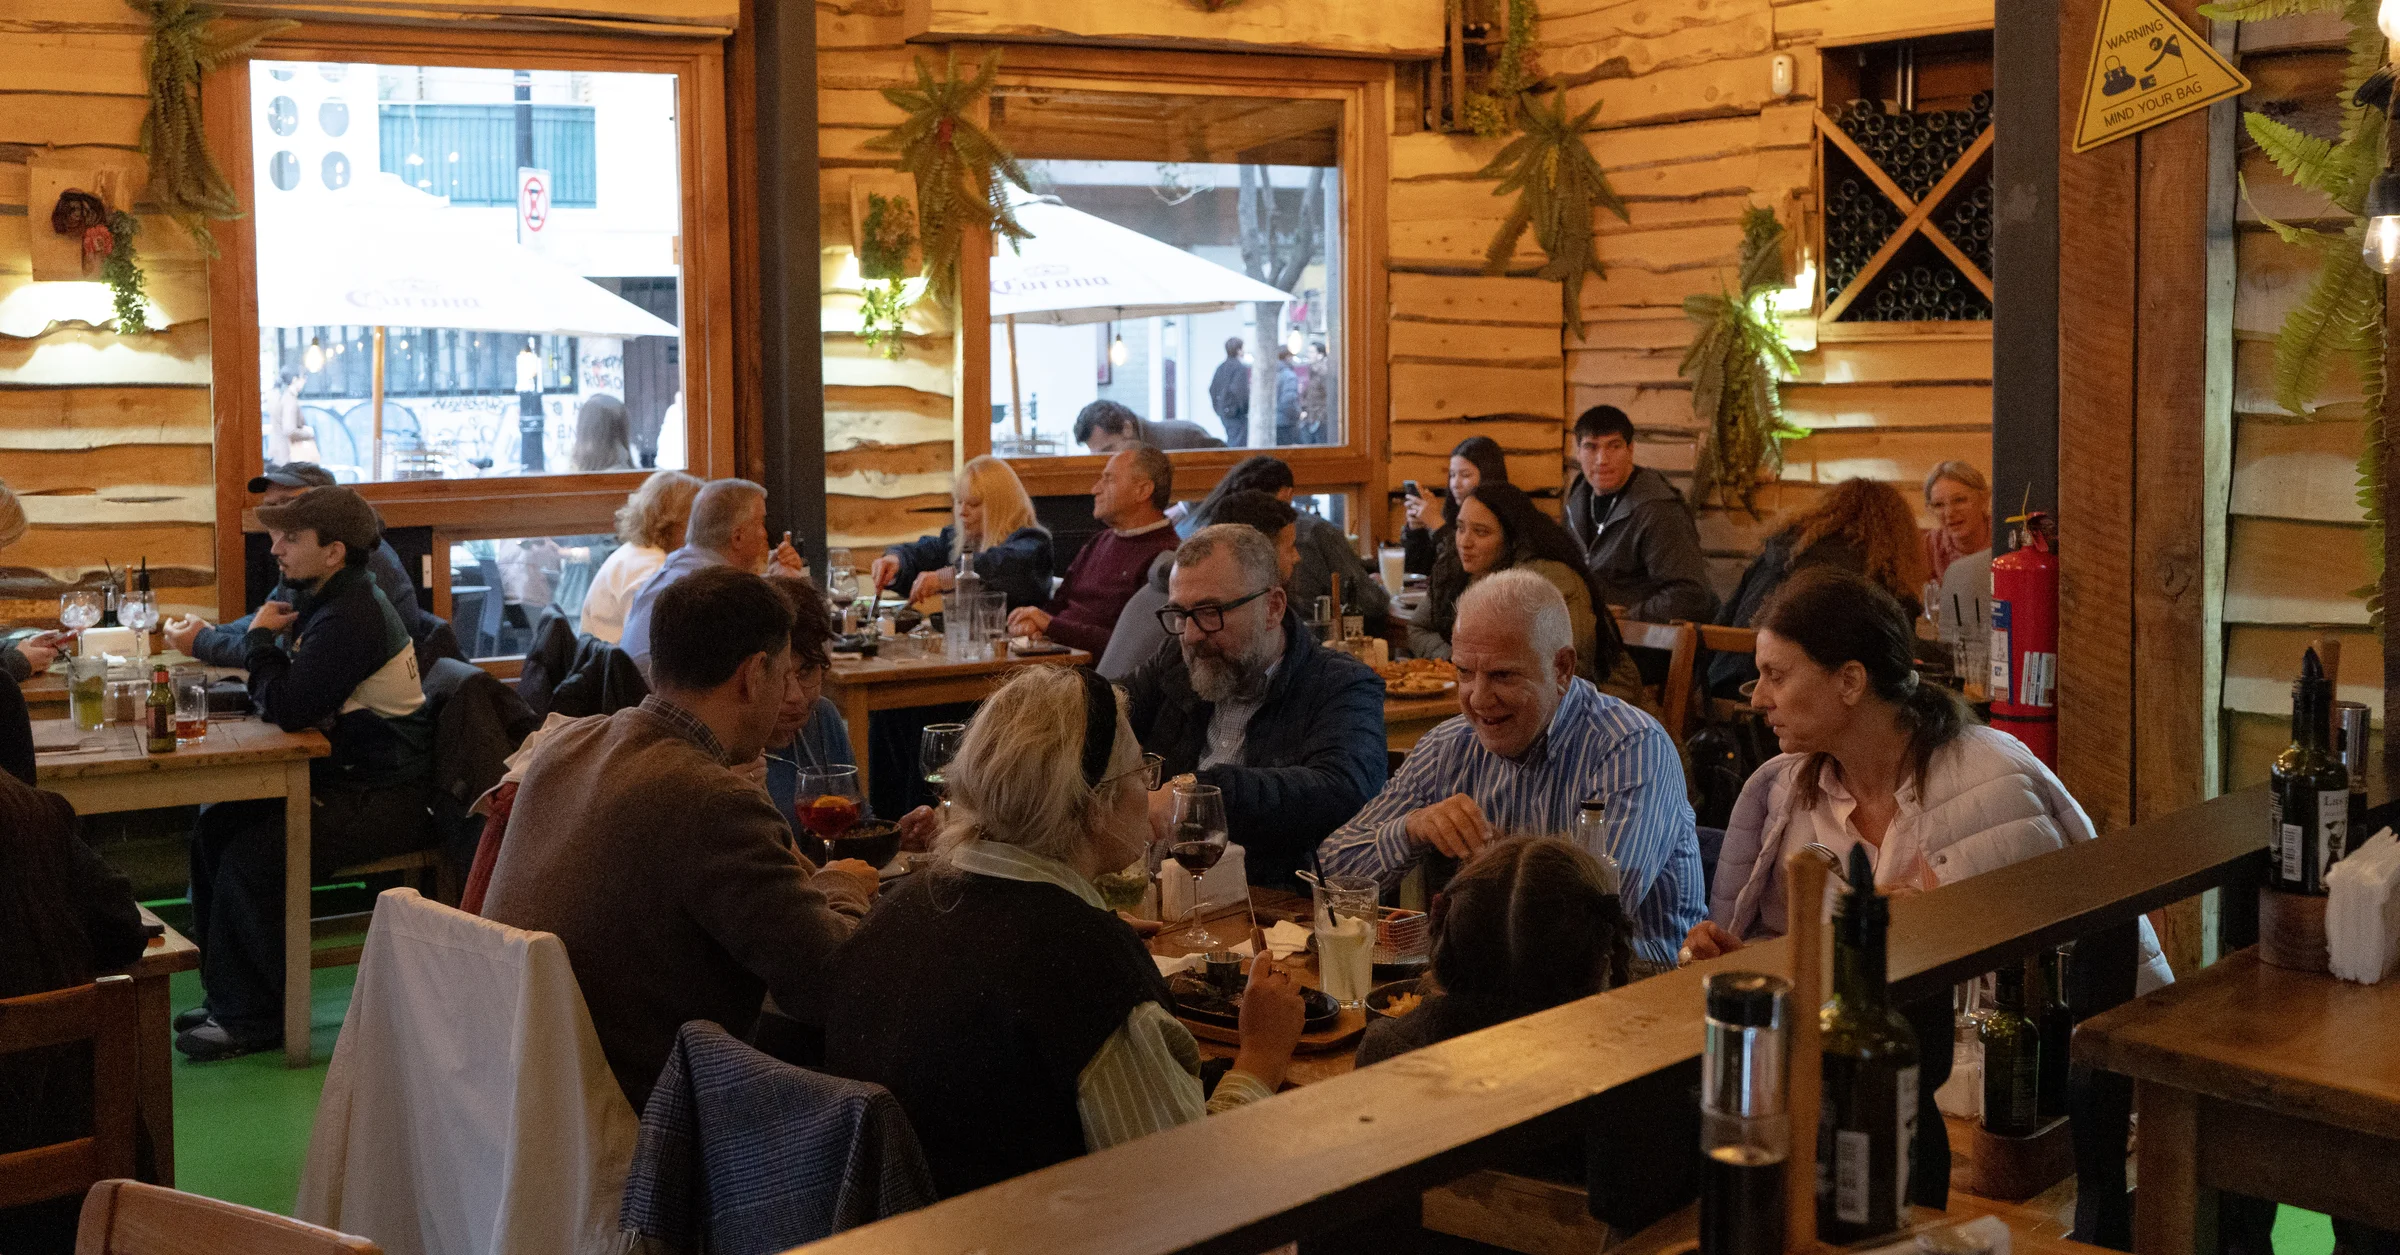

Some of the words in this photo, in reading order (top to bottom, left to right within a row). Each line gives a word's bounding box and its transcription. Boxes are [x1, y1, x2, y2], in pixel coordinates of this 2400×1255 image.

[2106, 19, 2164, 50] WARNING
[2104, 107, 2135, 127] MIND
[2137, 92, 2173, 114] YOUR
[2176, 81, 2203, 99] BAG
[344, 288, 484, 311] Corona
[989, 276, 1112, 296] Corona
